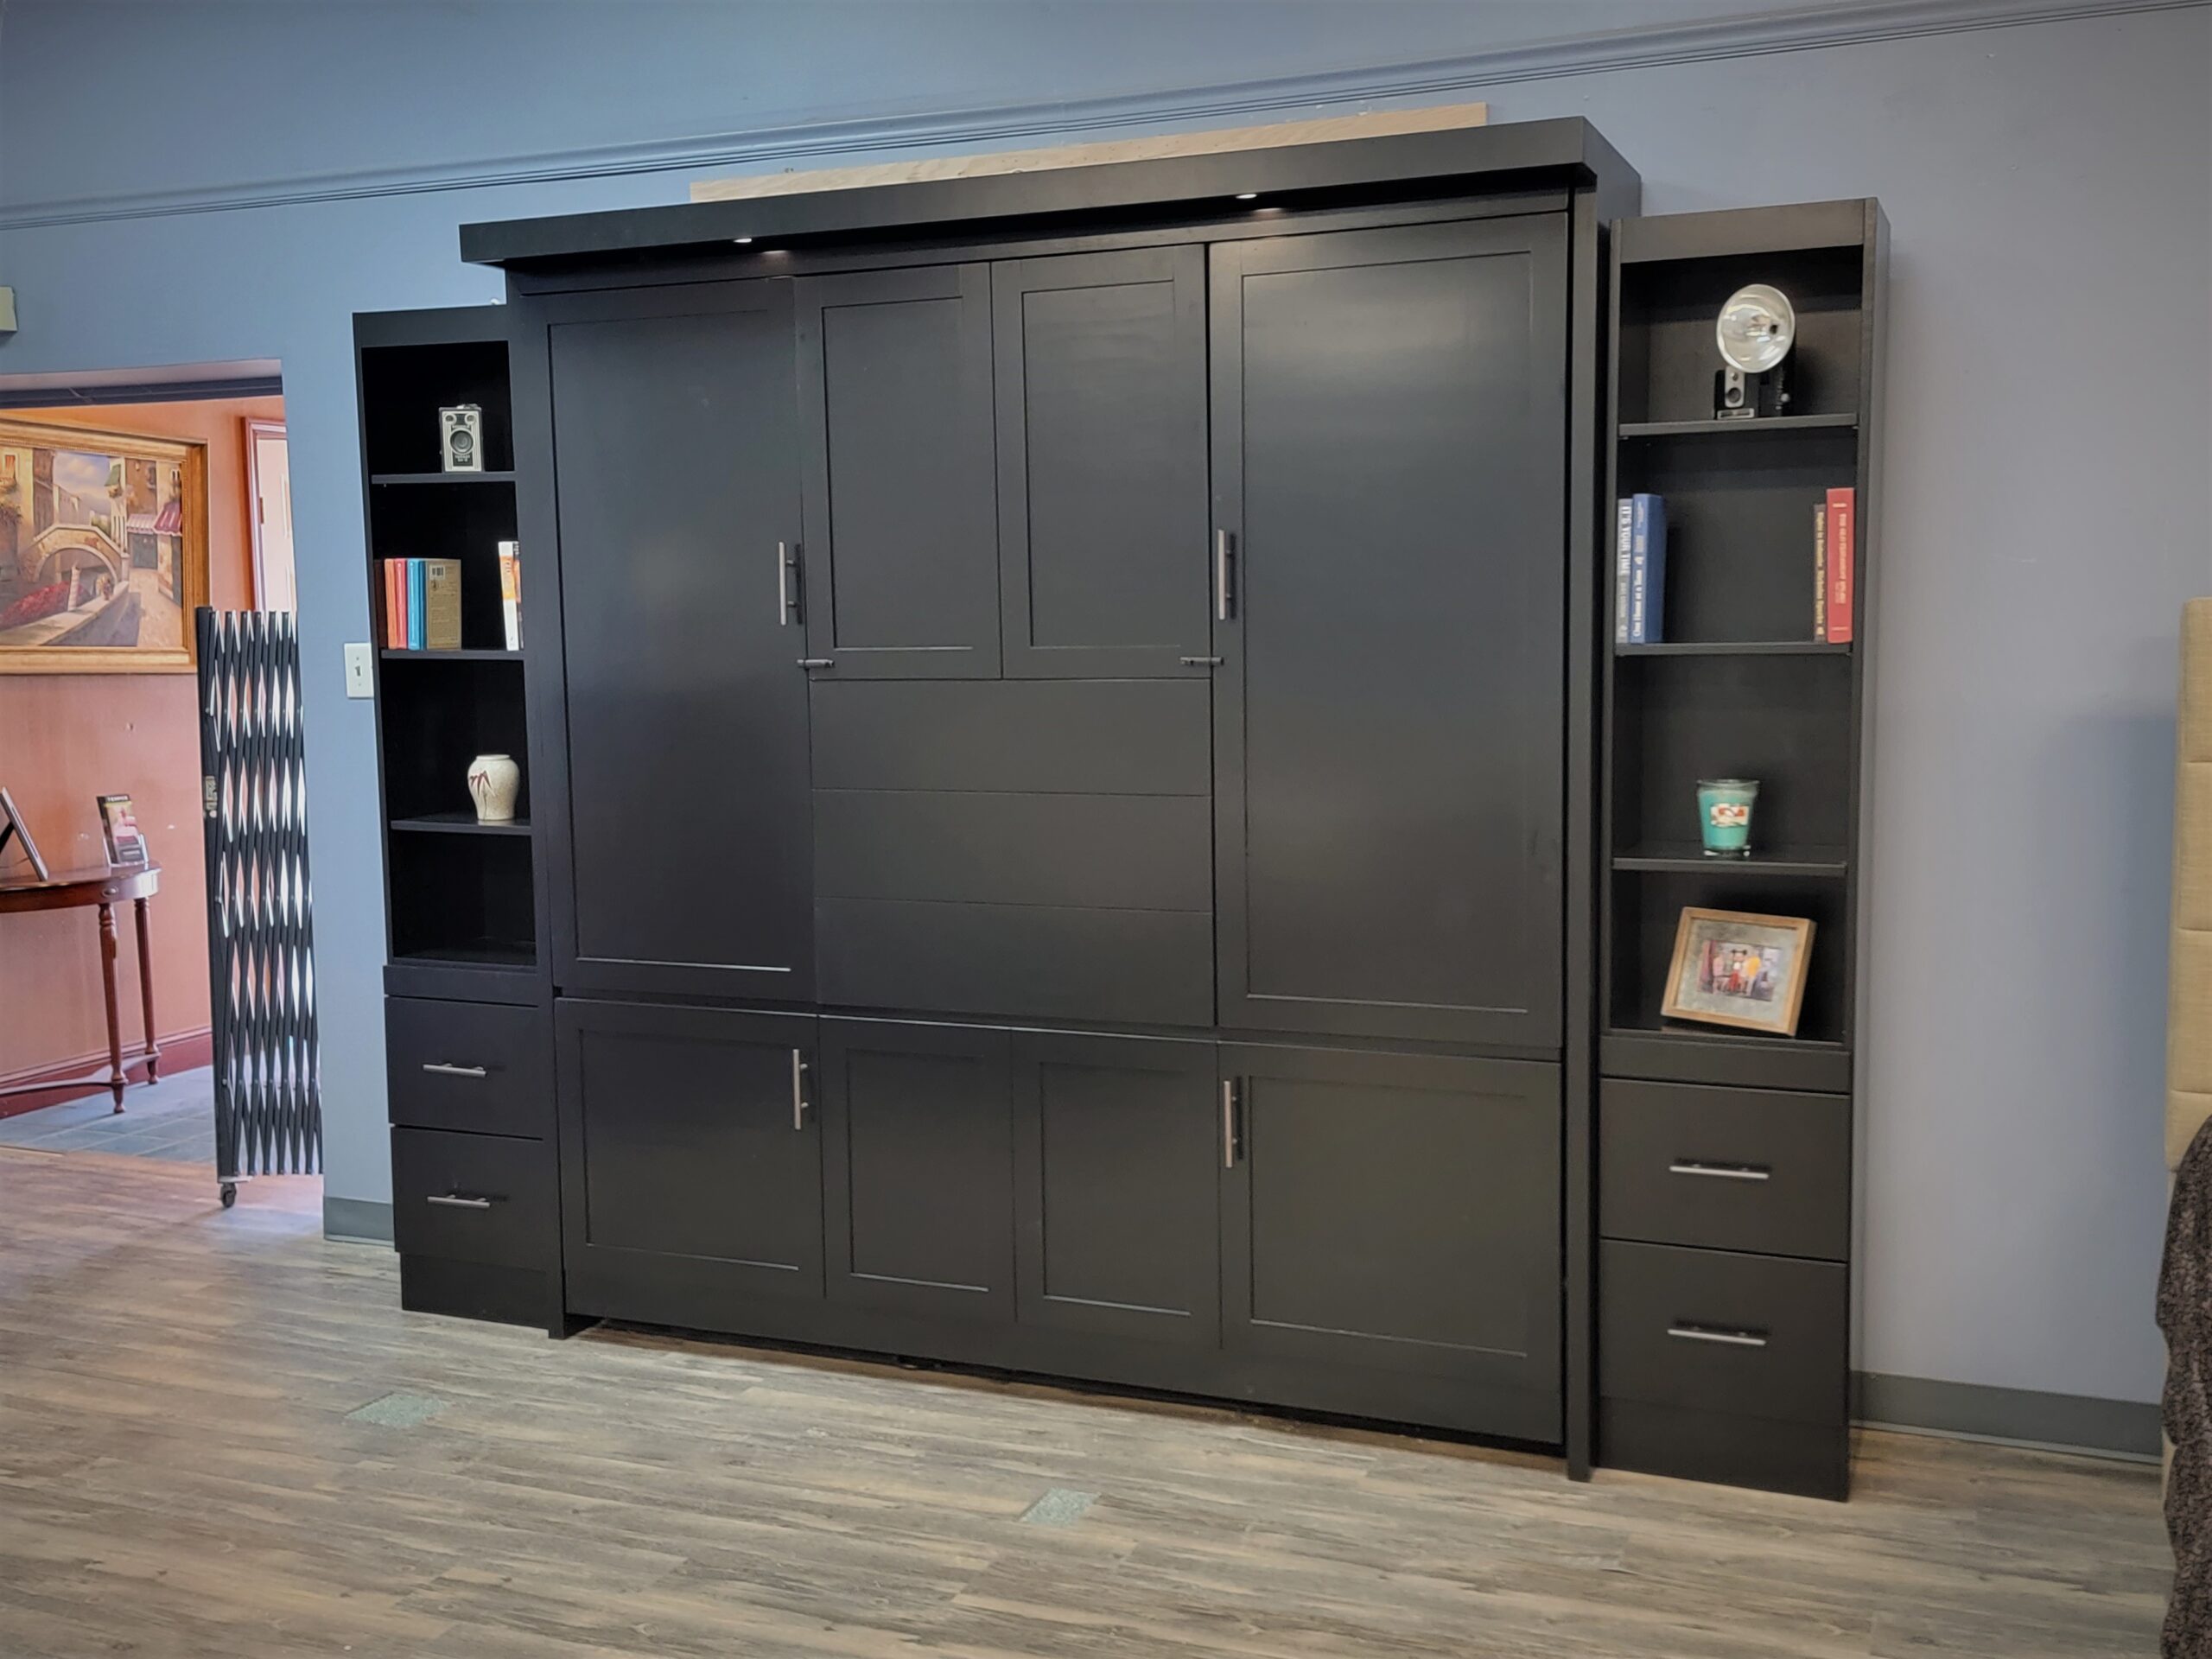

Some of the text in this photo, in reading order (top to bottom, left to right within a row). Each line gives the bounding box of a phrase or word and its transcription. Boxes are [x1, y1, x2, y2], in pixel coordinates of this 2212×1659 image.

[1621, 505, 1632, 524] IT'S
[1621, 525, 1631, 551] YOUR
[1620, 554, 1631, 575] TIME
